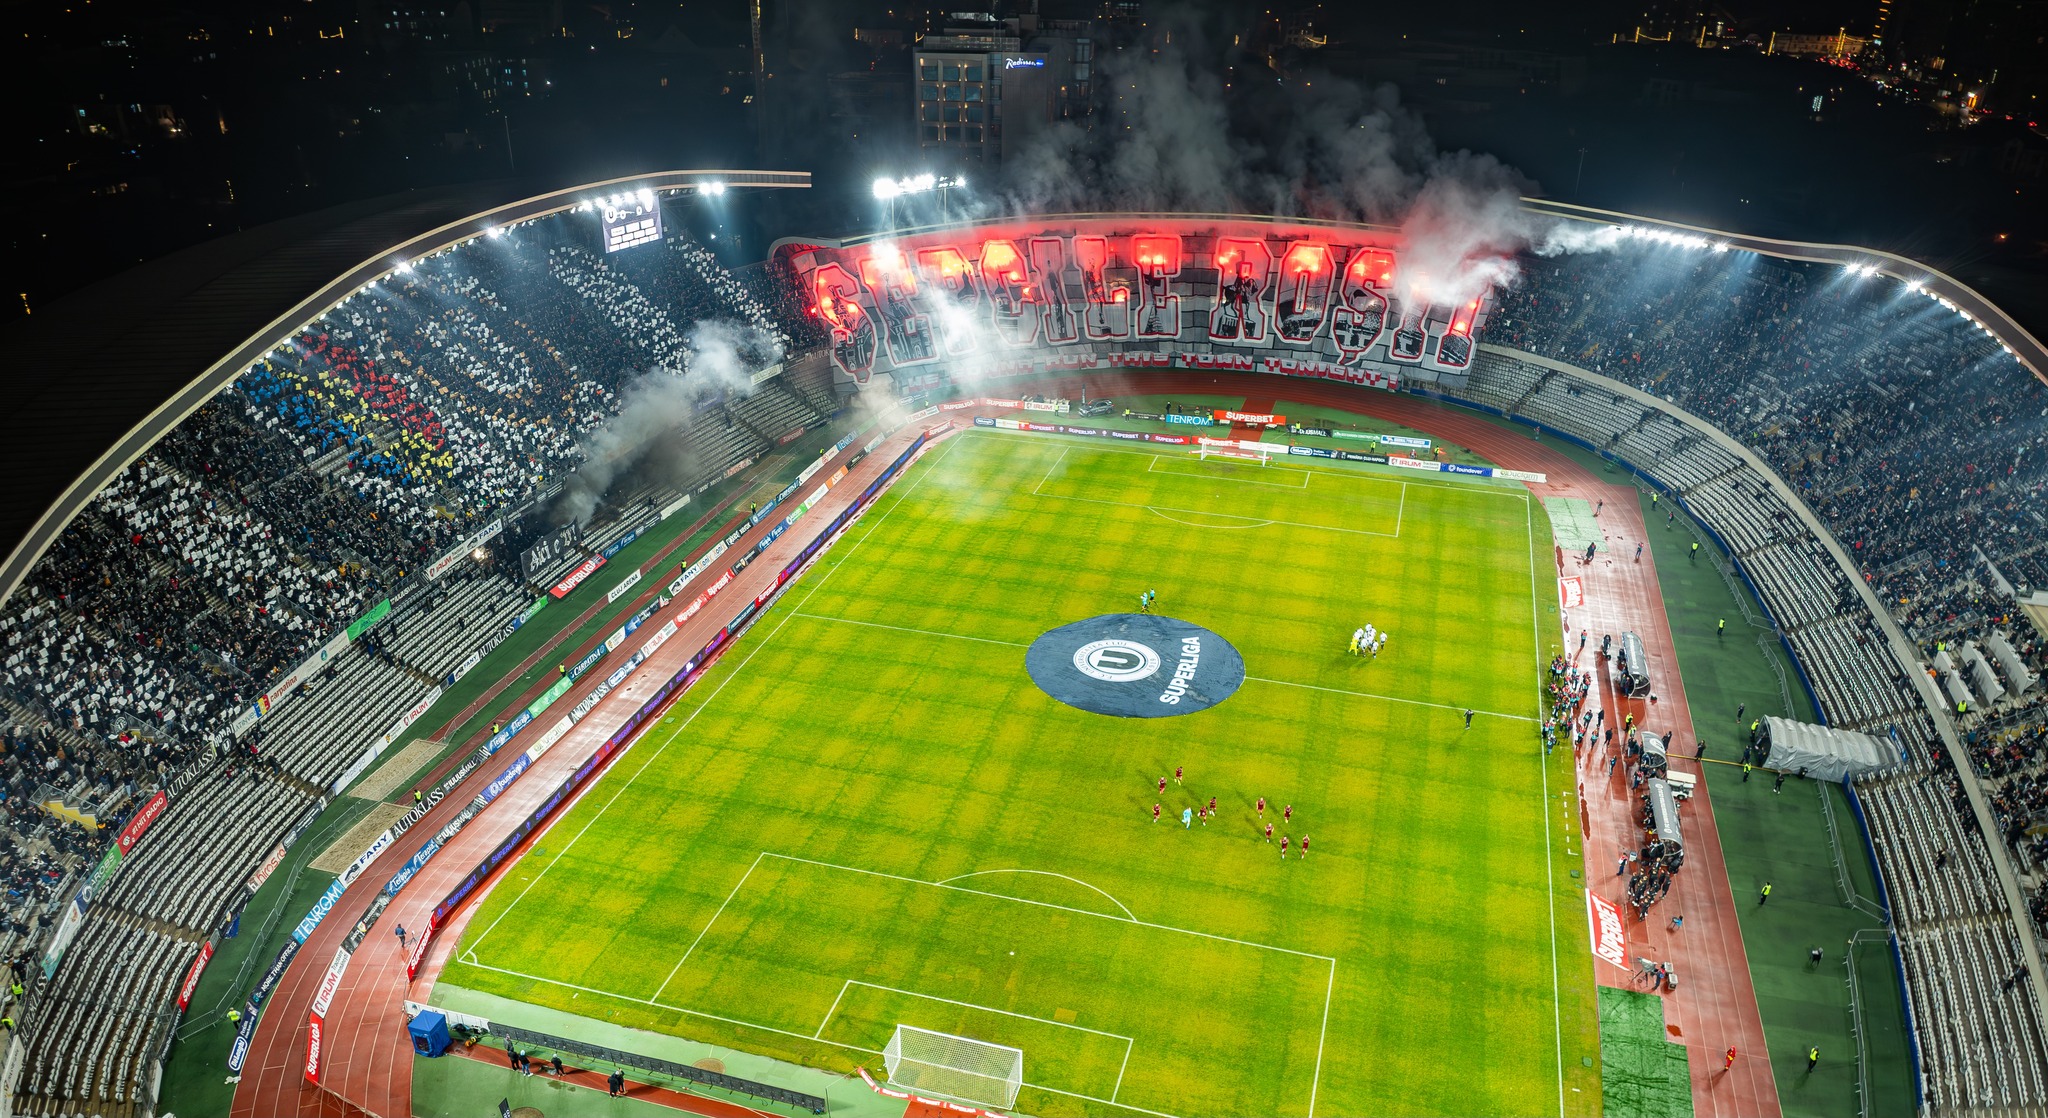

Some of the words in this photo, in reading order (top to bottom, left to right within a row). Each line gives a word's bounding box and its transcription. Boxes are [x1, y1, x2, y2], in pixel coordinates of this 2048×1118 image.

[1044, 353, 1098, 370] RUN
[1108, 352, 1170, 368] THIS
[1181, 352, 1254, 371] TOWN
[1169, 414, 1210, 426] TENROM
[1226, 411, 1274, 423] SUPERBET
[1399, 459, 1421, 468] IRUM
[1456, 466, 1483, 475] foundever
[479, 522, 500, 539] FANY
[557, 559, 596, 592] SUPERLIGA
[609, 587, 622, 599] CLUJ
[623, 574, 639, 590] ARENA
[680, 564, 698, 583] FANY
[480, 623, 515, 659] AUTOKLASS
[463, 655, 478, 669] FANY
[1097, 649, 1140, 670] U
[1160, 636, 1200, 705] SUPERLIGA
[409, 701, 429, 720] IRUM
[166, 748, 214, 802] AUTOKLASS
[137, 815, 147, 830] HIT
[145, 797, 164, 819] RADIO
[392, 787, 445, 838] AUTOKLASS
[359, 834, 388, 864] FANY
[491, 832, 521, 864] SUPERLIGA
[91, 852, 116, 887] AROBS
[256, 848, 286, 883] hiros.ro
[447, 875, 478, 906] SUPERBET
[296, 884, 343, 941] TENROM
[410, 919, 433, 970] SUPERBET
[1591, 894, 1625, 964] SUPERBET
[182, 949, 208, 1002] SUPERBET
[260, 974, 274, 992] MORE
[271, 960, 282, 977] THAN
[280, 941, 297, 963] OFFICES
[320, 971, 338, 1003] IRUM
[20, 970, 49, 1048] AUTOKLASS
[307, 1022, 319, 1075] SUPERLIGA
